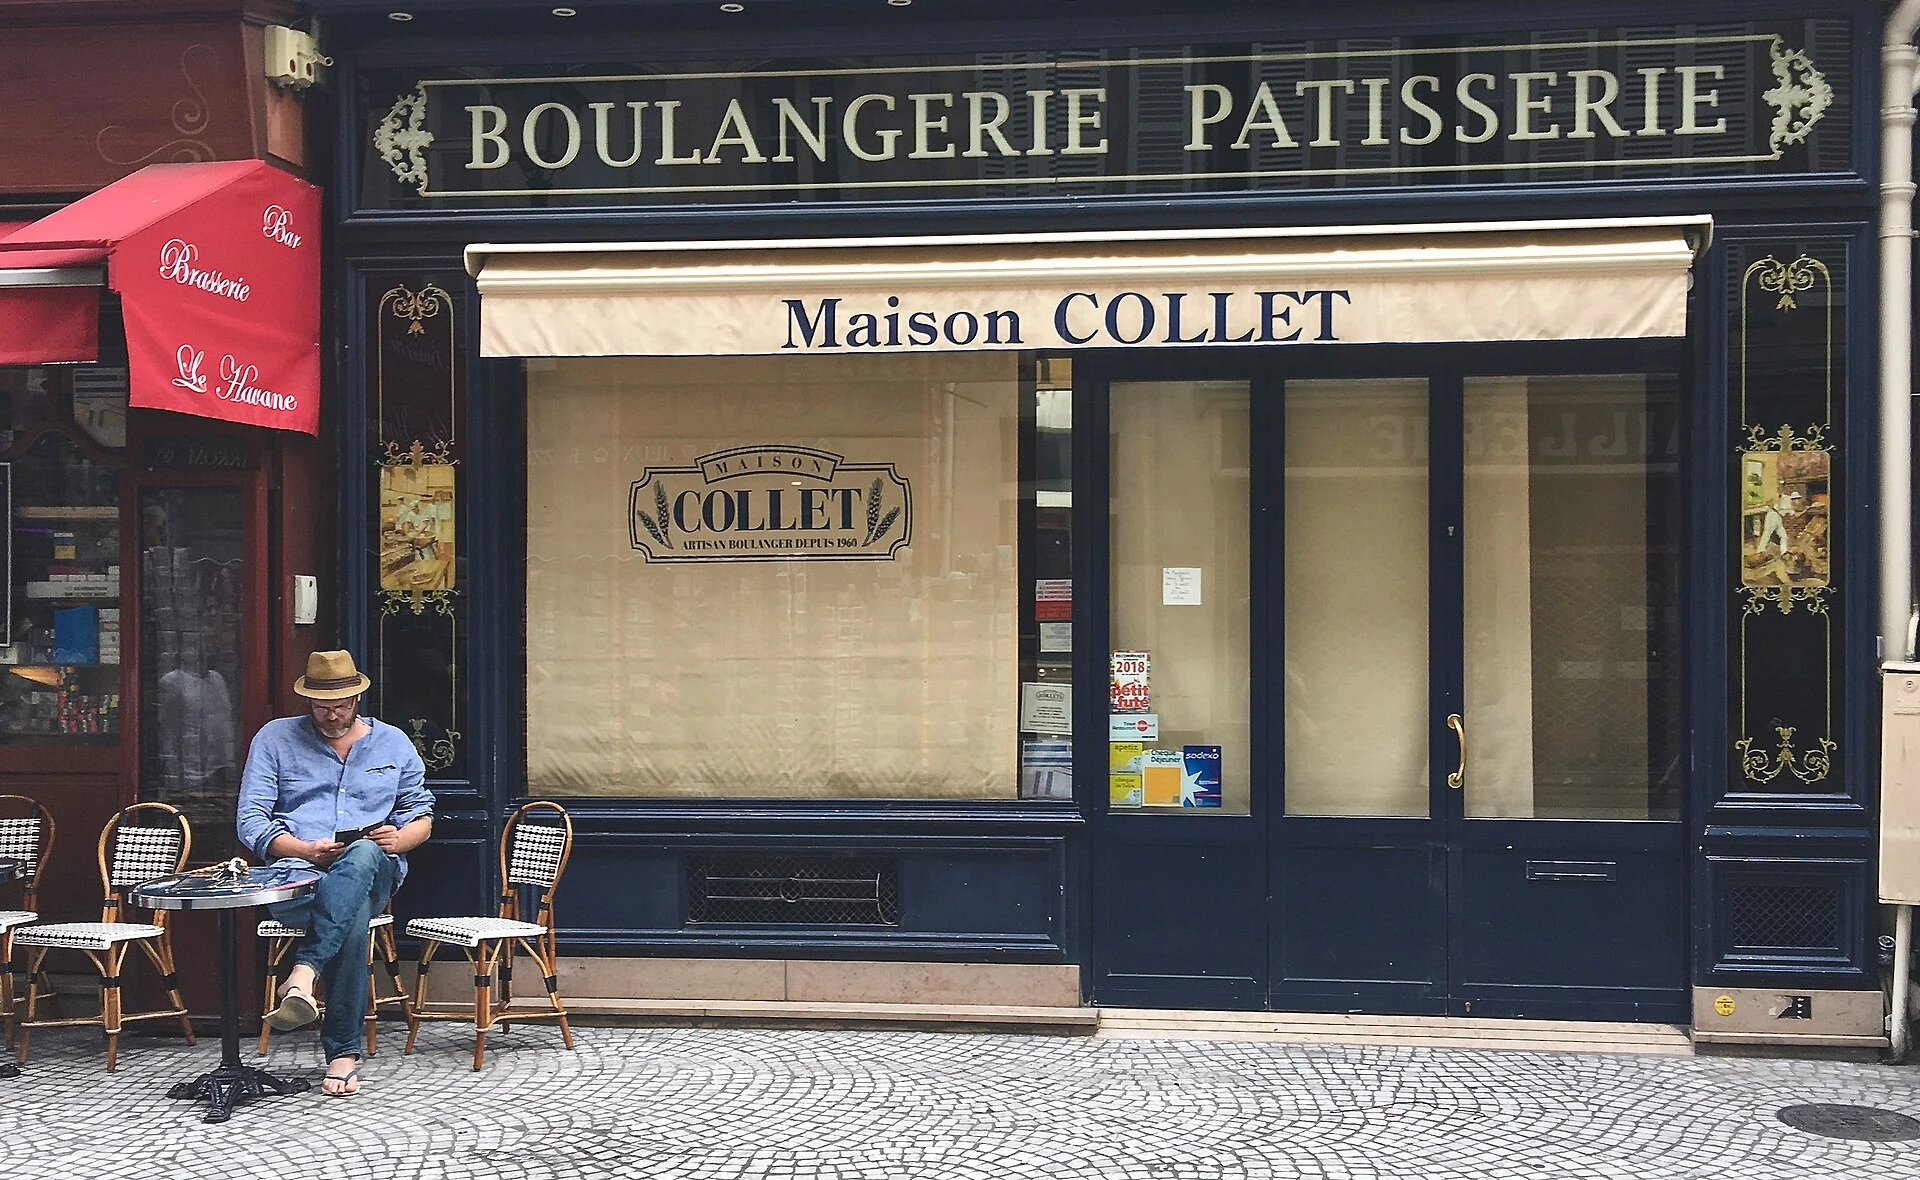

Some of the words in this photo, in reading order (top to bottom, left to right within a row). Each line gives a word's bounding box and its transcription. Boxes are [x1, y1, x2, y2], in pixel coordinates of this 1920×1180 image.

[464, 87, 1109, 170] BOULANGERIE
[1182, 65, 1727, 151] PATISSERIE
[262, 204, 301, 249] Bar
[159, 238, 250, 302] Brasserie
[780, 296, 1024, 349] Maison
[1053, 290, 1351, 344] COLLET
[171, 343, 207, 393] Le
[215, 354, 298, 411] Havane
[715, 455, 824, 475] MAISON
[672, 488, 862, 533] COLLET
[683, 539, 726, 550] ARTISAN
[728, 538, 793, 550] BOULANGER
[796, 538, 834, 548] DEPUIS
[837, 538, 858, 548] 1960
[1116, 661, 1145, 673] 2018
[1111, 685, 1149, 698] petit
[1185, 750, 1219, 760] sodexo
